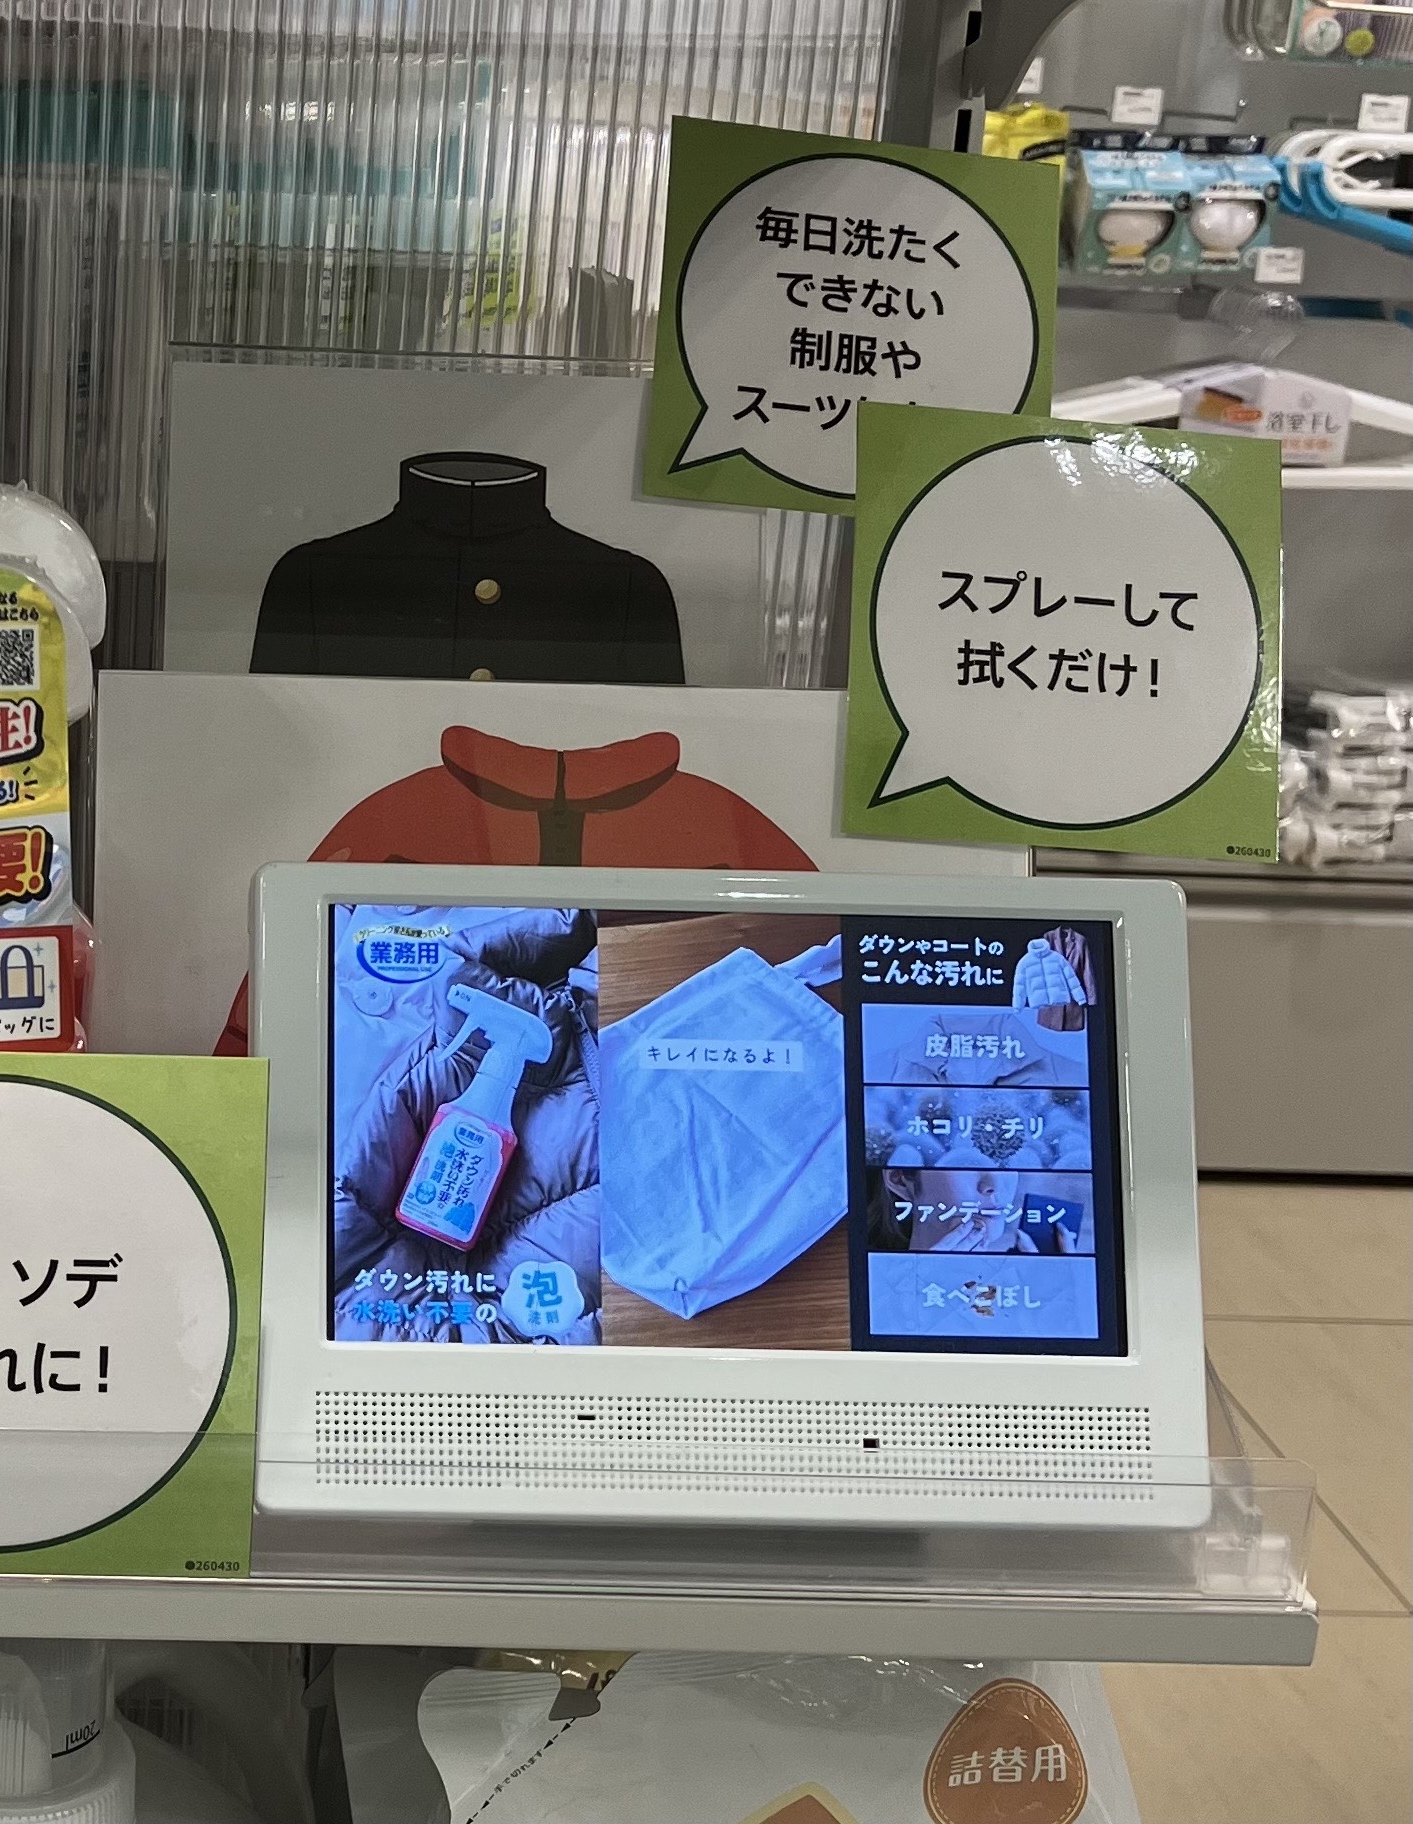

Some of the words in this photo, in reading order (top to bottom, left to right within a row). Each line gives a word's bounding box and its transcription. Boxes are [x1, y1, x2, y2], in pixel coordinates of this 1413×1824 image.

[754, 205, 961, 269] 毎日洗たく
[776, 271, 945, 321] できない
[789, 327, 922, 379] 制服や
[732, 384, 868, 431] スーツ
[938, 570, 1199, 631] スプレーして
[956, 638, 1159, 698] 拭くだけ！
[1235, 846, 1272, 858] 260430
[369, 941, 440, 965] 業務用
[857, 933, 1005, 956] ダウンやコートの
[860, 959, 1005, 987] こんな汚れに
[646, 1045, 791, 1065] キレイになるよ！
[925, 1033, 1026, 1060] 皮脂汚れ
[906, 1115, 1045, 1140] ホコリ・チリ
[893, 1200, 1067, 1224] ファンデーション
[353, 1267, 497, 1294] ダウン汚れに
[520, 1269, 564, 1310] 泡
[351, 1299, 498, 1326] 水洗い不要の
[195, 1560, 240, 1572] 260430
[947, 1743, 1069, 1788] 詰替用
